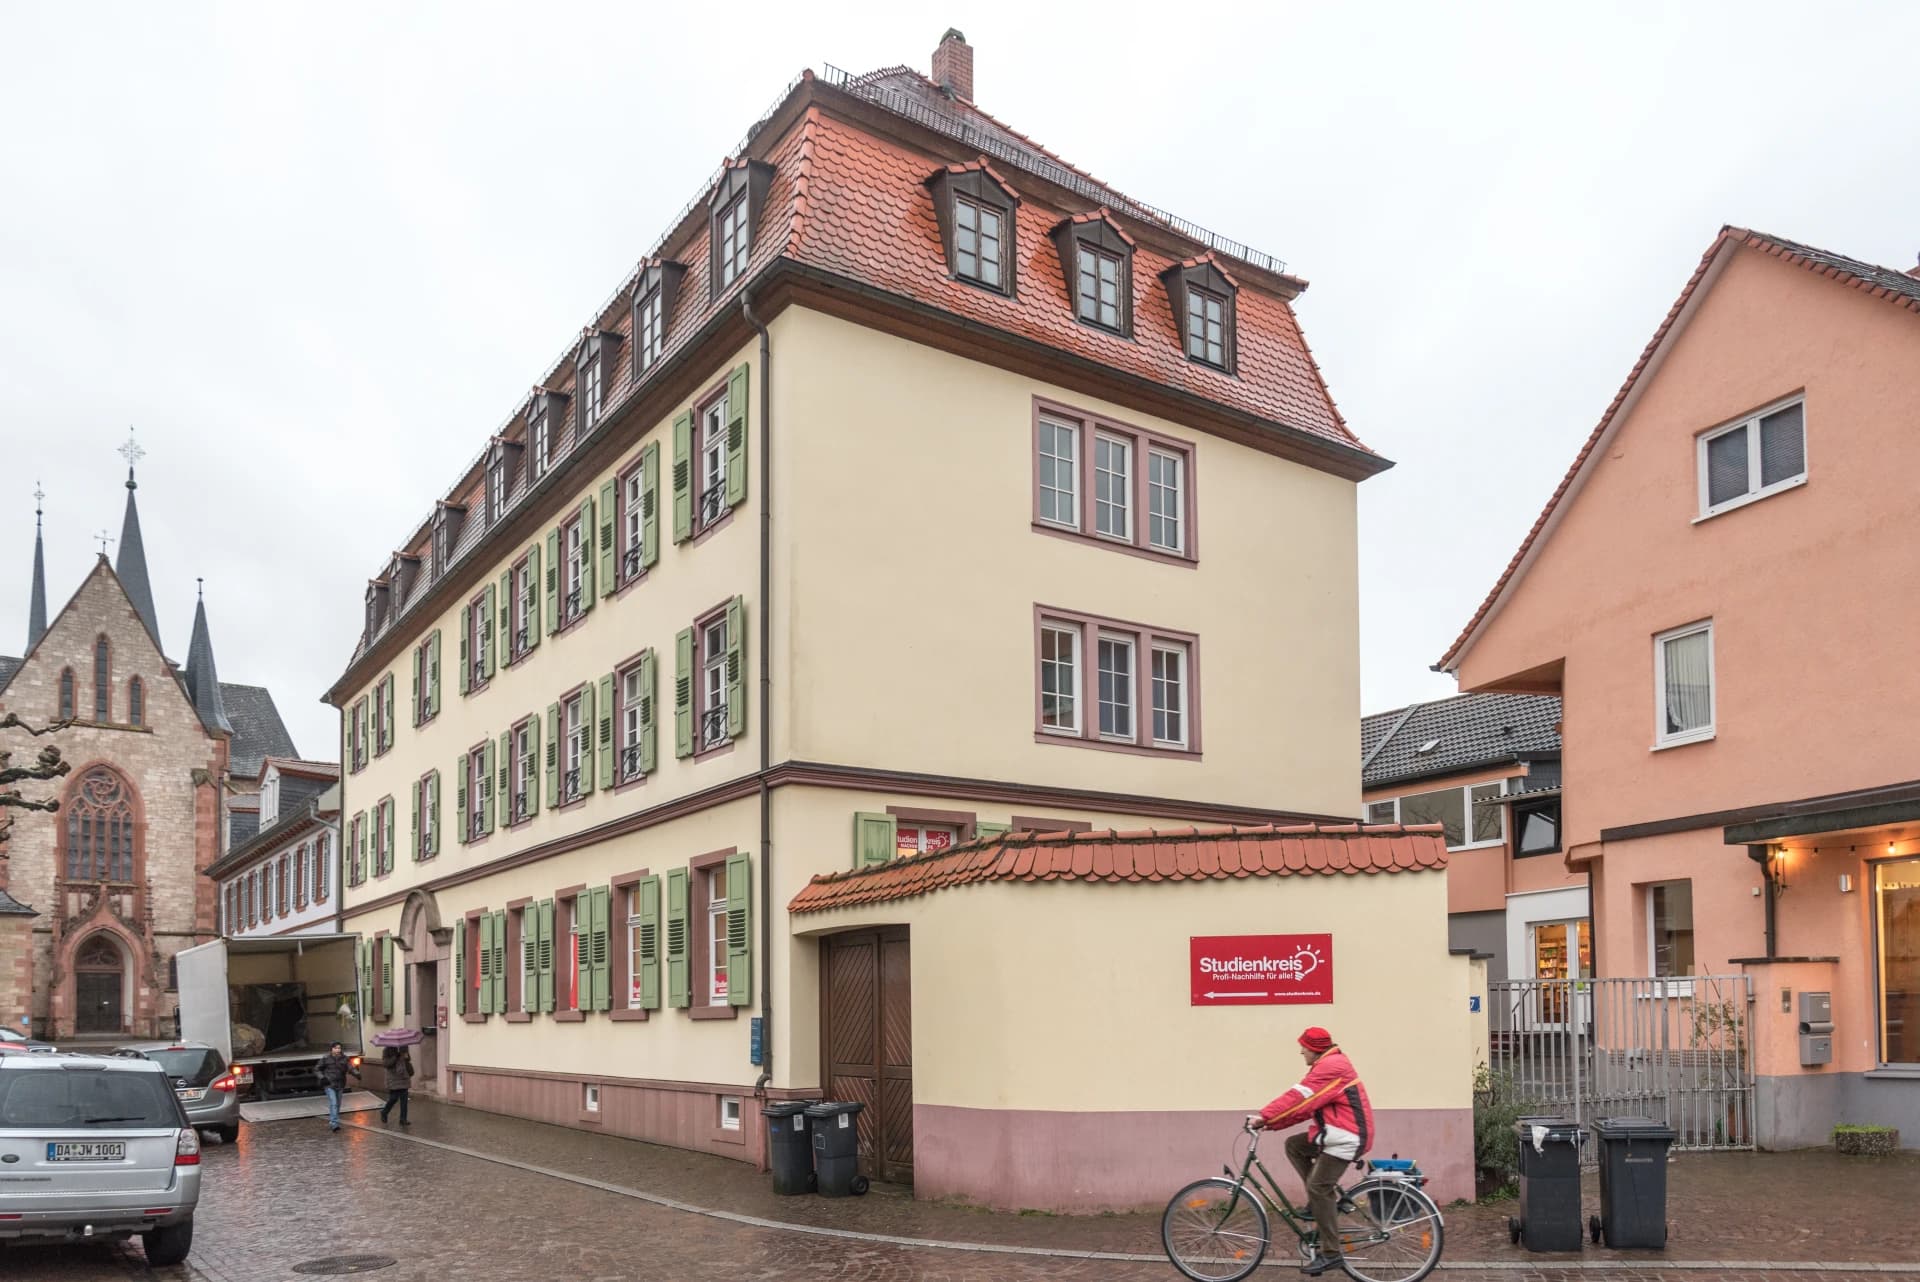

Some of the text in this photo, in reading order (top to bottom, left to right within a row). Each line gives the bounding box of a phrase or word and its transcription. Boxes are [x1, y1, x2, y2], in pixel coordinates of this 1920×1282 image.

[1200, 955, 1303, 973] Studienkreis
[1212, 972, 1293, 981] Profi-Nachhilfe für alle!
[56, 1144, 122, 1156] DA JW 1001
